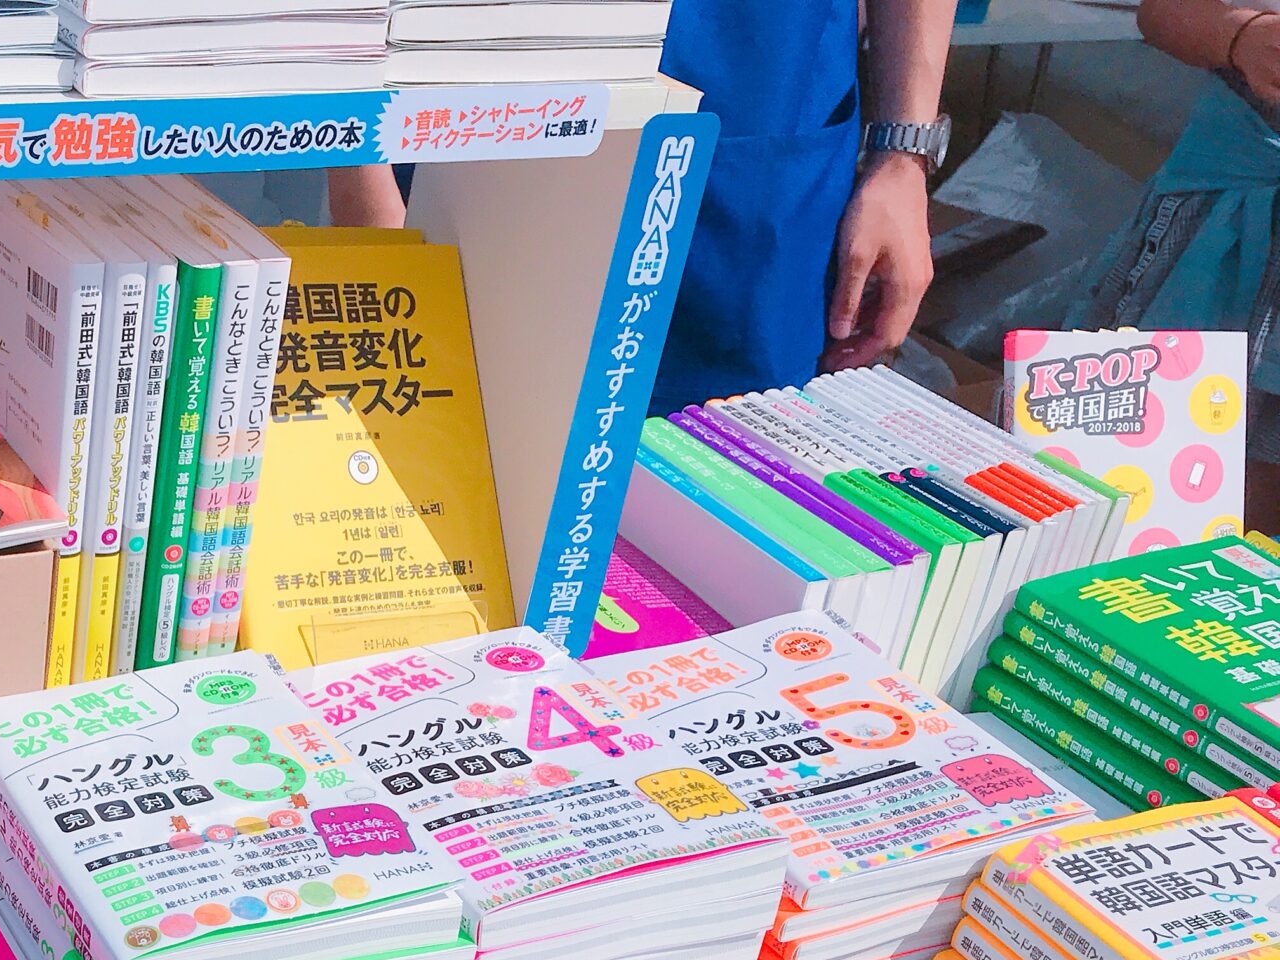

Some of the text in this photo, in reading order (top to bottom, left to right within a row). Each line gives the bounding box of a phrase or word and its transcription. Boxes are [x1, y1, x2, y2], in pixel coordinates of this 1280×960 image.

[415, 95, 586, 130] 音読 シャドーイング
[1028, 347, 1159, 401] K-POP
[1087, 422, 1142, 433] 2017-2018
[375, 636, 410, 649] HANA
[303, 654, 428, 709] この1冊で
[322, 667, 455, 726] 必ず合格！
[570, 681, 614, 709] 見本
[876, 676, 922, 705] 見本
[11, 701, 159, 760] 必ず合格！
[527, 685, 626, 758] 4
[779, 671, 916, 750] 5
[289, 723, 328, 753] 見本
[191, 723, 308, 801] 3
[313, 767, 354, 789] 級
[42, 767, 195, 811] 能力検定試験
[374, 865, 420, 879] HANA
[1051, 822, 1270, 885] 単語カードで
[1141, 907, 1254, 943] 入門単語編
